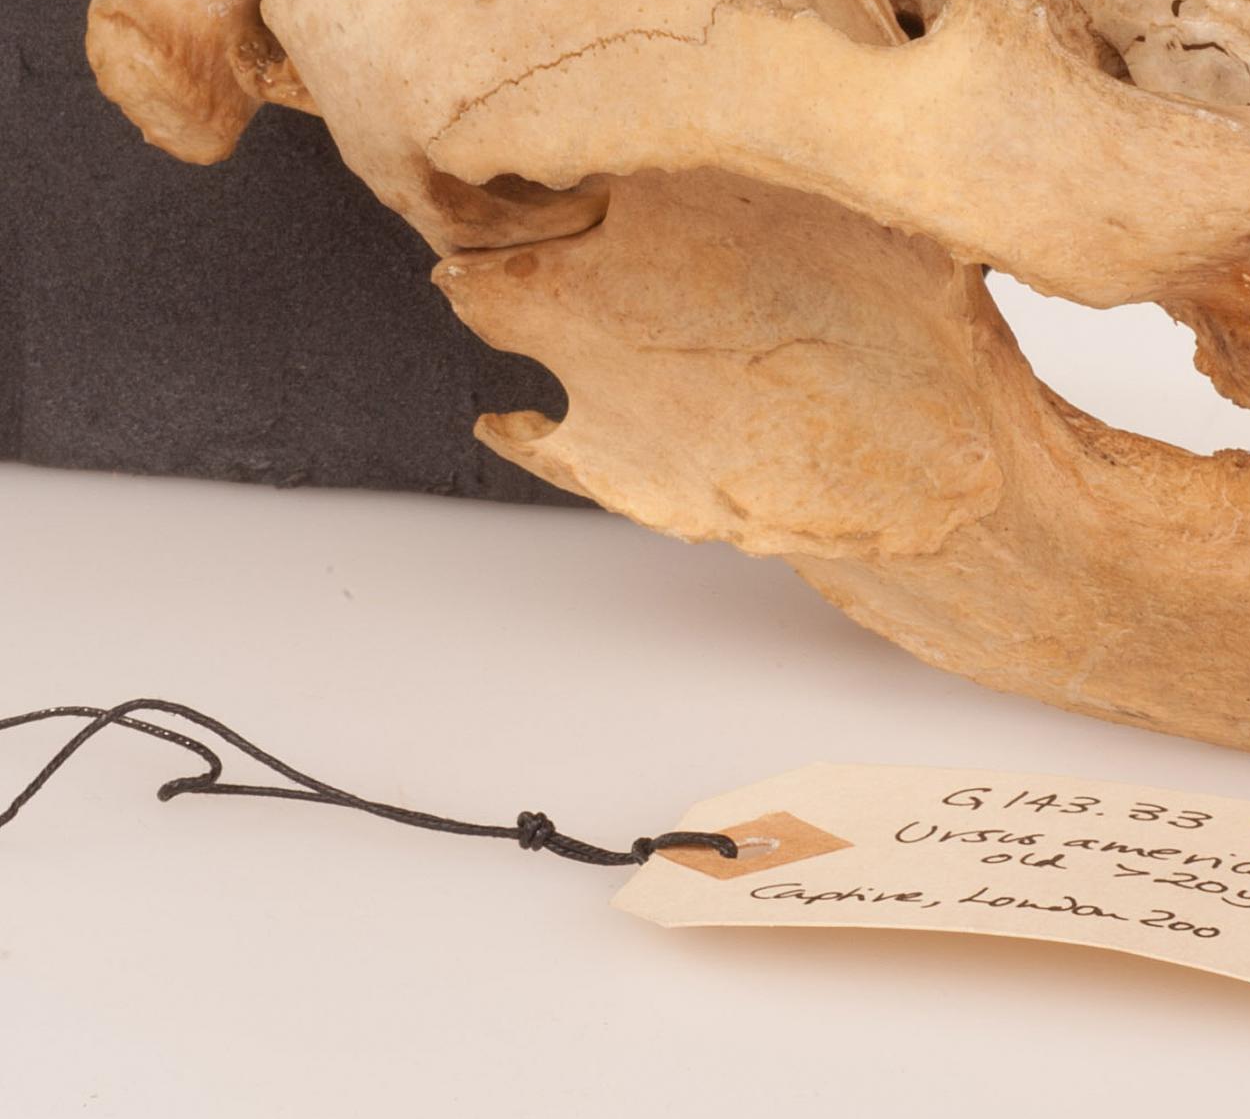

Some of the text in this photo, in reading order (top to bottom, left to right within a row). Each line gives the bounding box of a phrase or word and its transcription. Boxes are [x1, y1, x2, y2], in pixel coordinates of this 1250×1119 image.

[894, 821, 1046, 847] Ursus
[980, 853, 1068, 871] old
[749, 883, 943, 910] Captive,
[957, 887, 1130, 923] London
